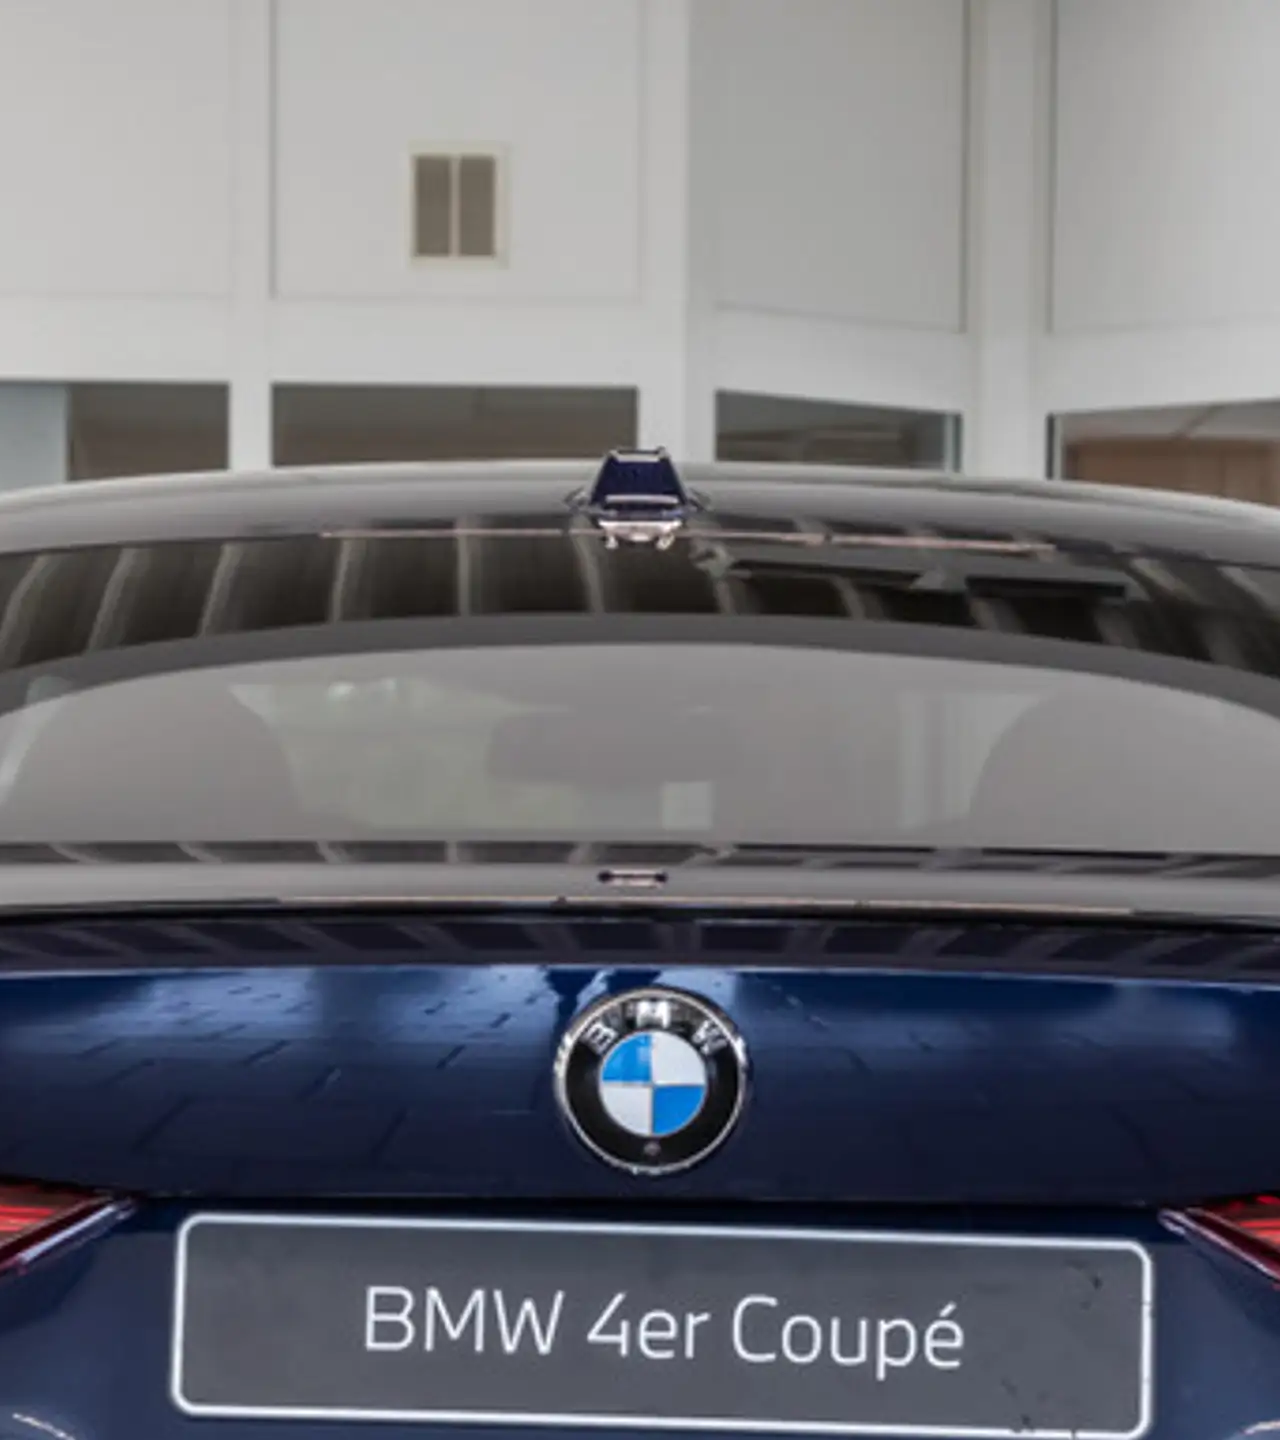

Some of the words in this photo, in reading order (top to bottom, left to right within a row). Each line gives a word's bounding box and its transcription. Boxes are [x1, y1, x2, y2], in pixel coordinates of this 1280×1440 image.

[578, 999, 728, 1056] BMW
[365, 1285, 566, 1356] BMW
[586, 1291, 711, 1359] 4er
[732, 1293, 965, 1381] Coupé
